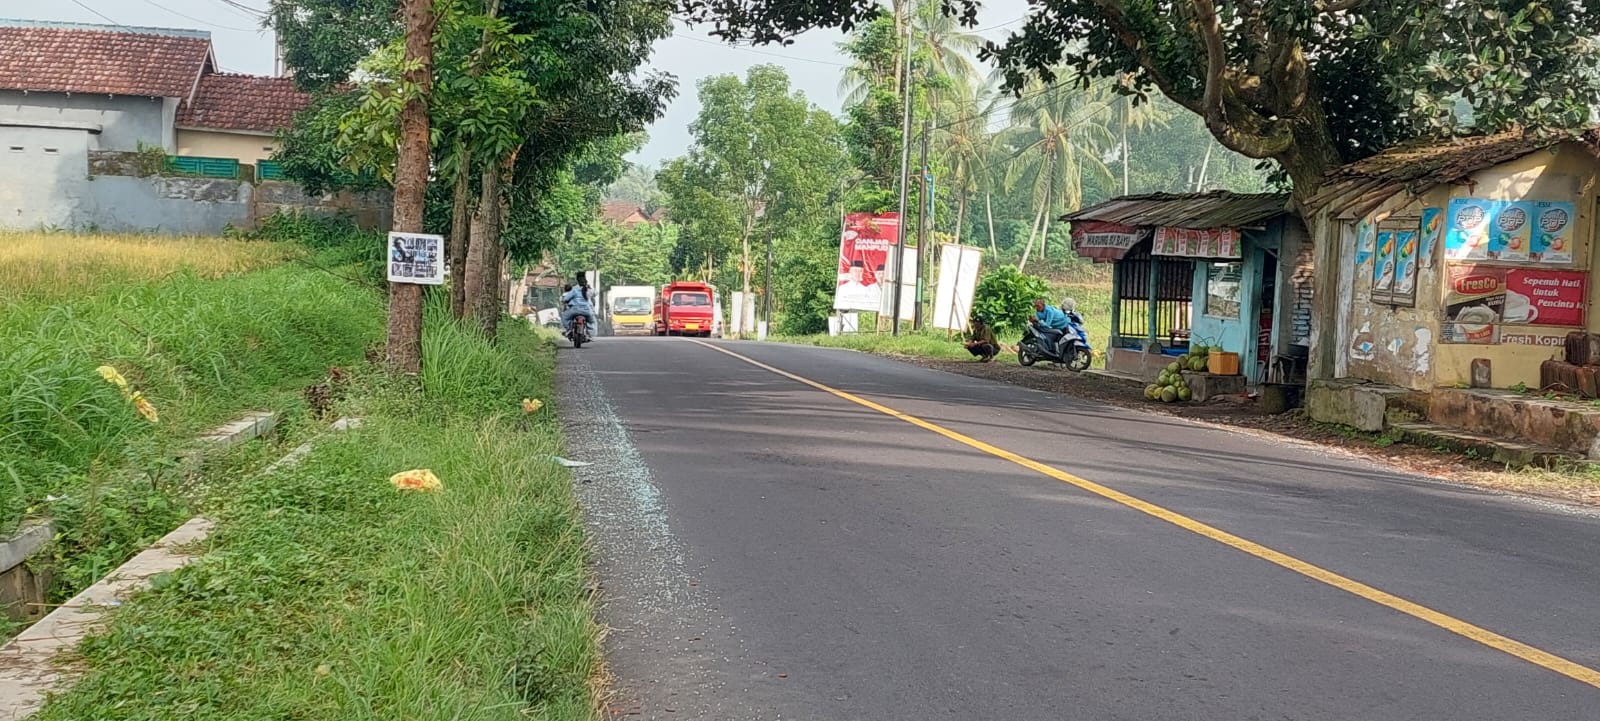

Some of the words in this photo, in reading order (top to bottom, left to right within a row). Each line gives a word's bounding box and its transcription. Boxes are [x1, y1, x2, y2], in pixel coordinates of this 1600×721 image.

[1461, 277, 1497, 291] FresCo
[1523, 276, 1560, 286] Sepenuh
[1562, 279, 1581, 288] Hati
[1533, 287, 1559, 297] Untuk
[1537, 299, 1575, 309] Pencinta
[1500, 334, 1532, 345] Fresh
